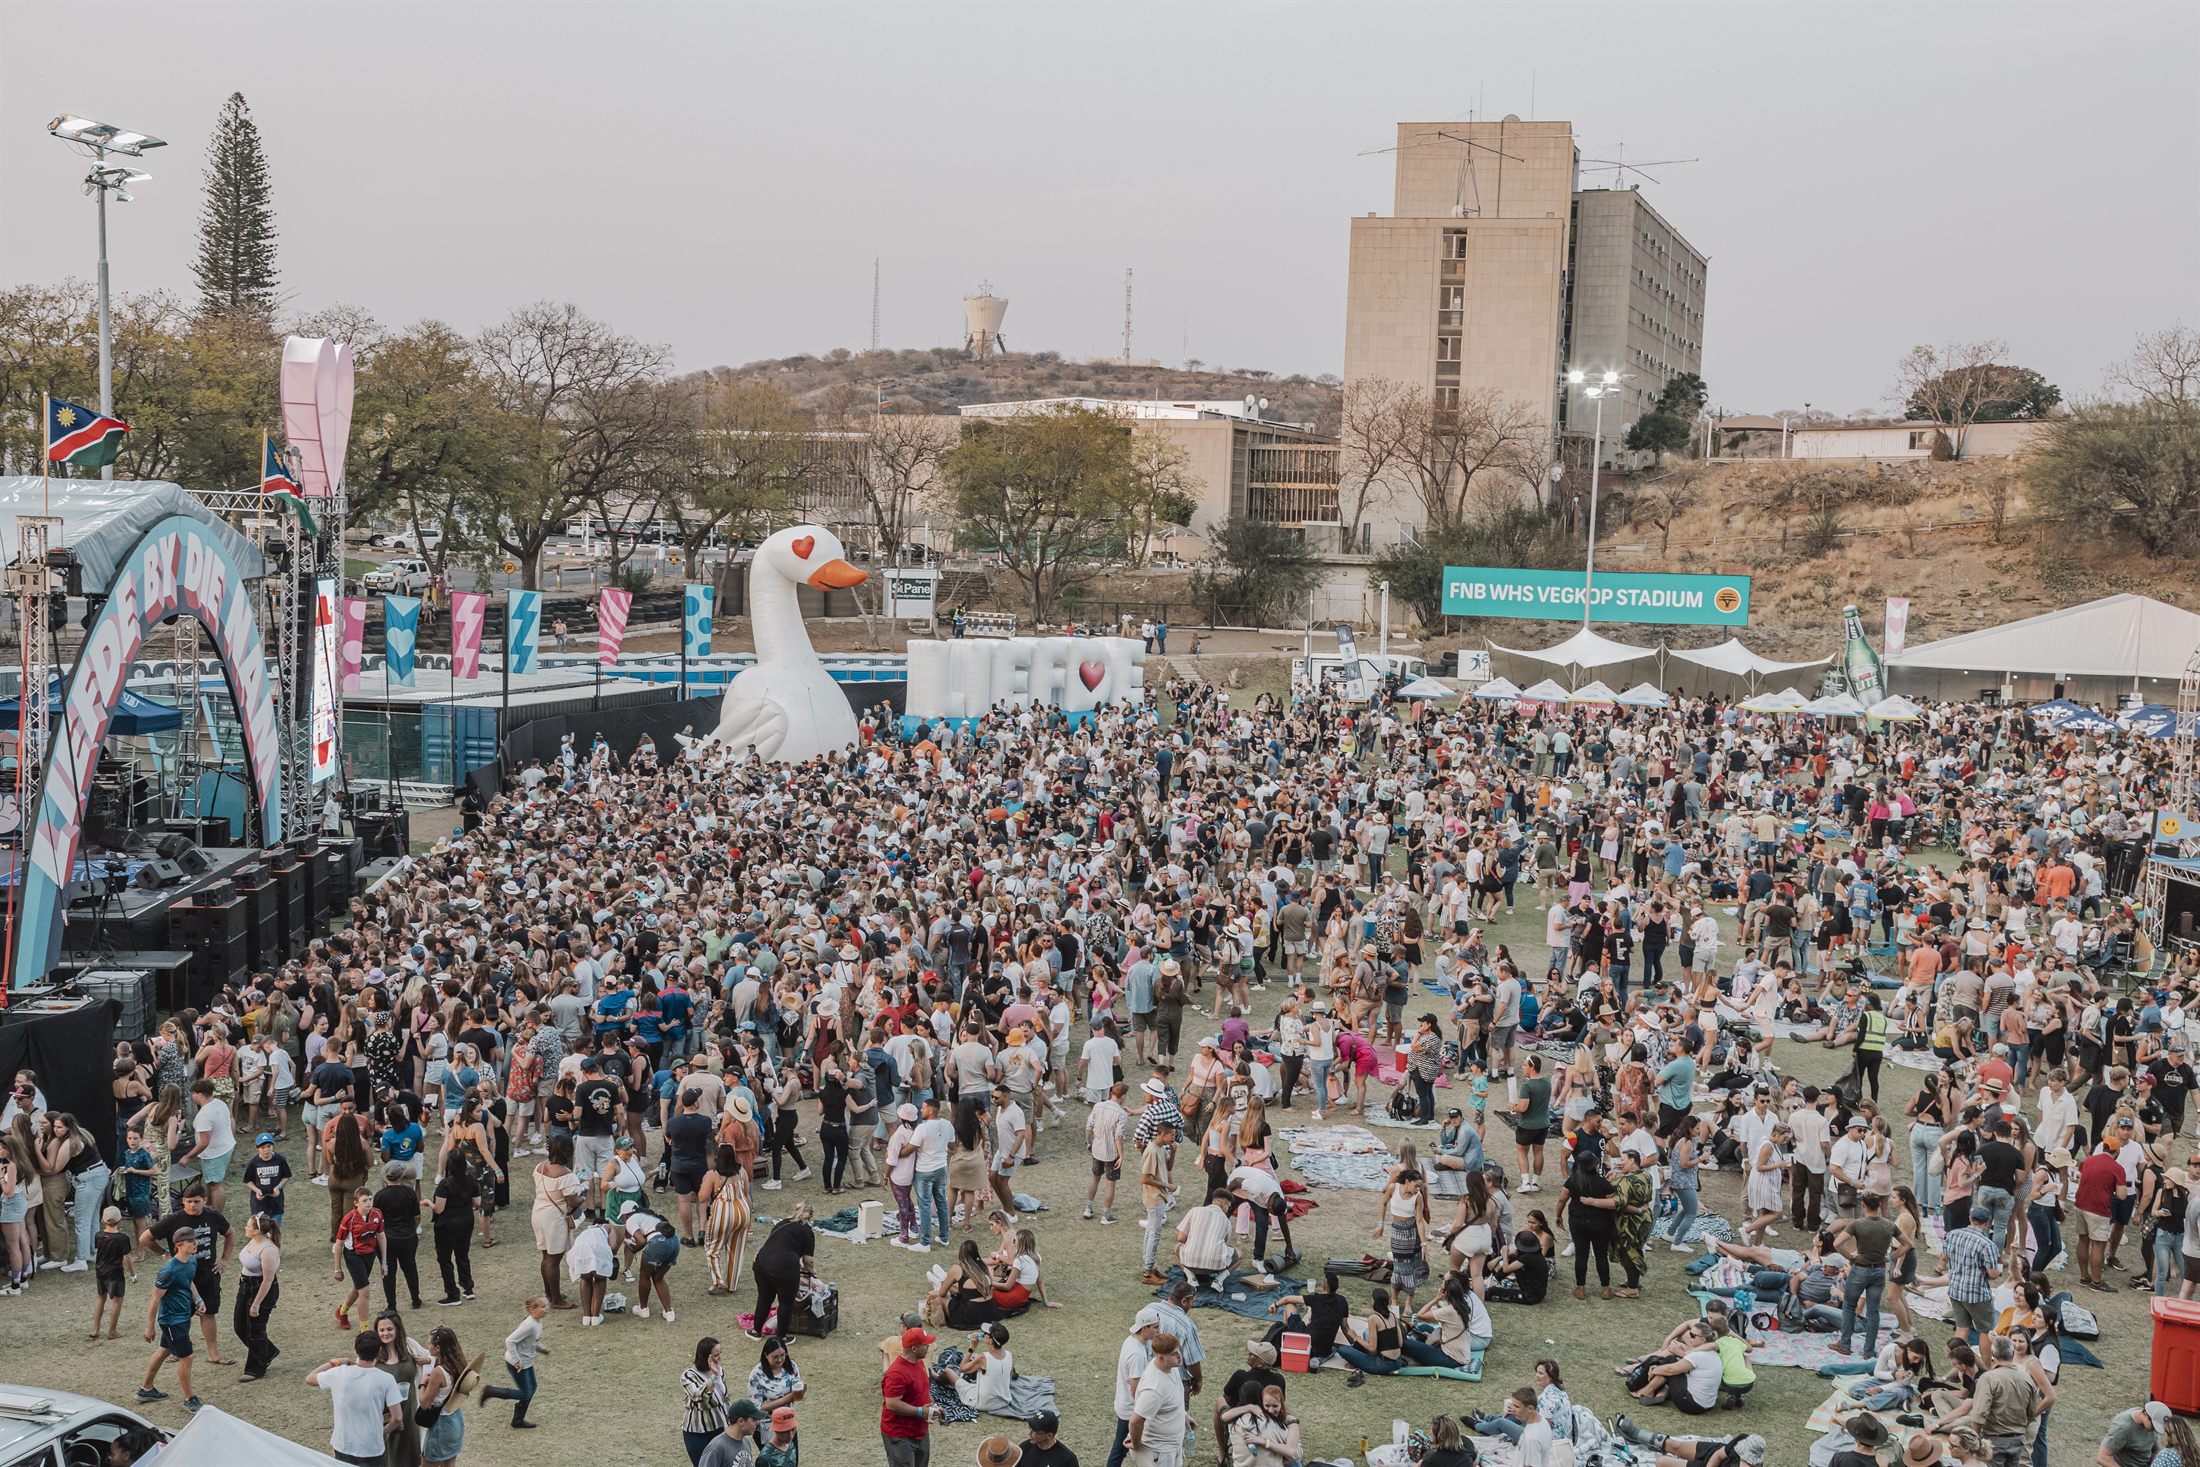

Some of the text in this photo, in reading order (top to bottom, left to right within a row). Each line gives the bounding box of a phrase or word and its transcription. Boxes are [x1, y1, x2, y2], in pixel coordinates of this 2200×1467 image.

[1450, 582, 1703, 608] FNB WHS VEGKOP STADIUM
[31, 569, 141, 889] LIEFDE
[144, 532, 180, 622] BY
[184, 531, 226, 634] DIE
[224, 580, 279, 806] NAM
[906, 637, 1147, 719] LIEFDE
